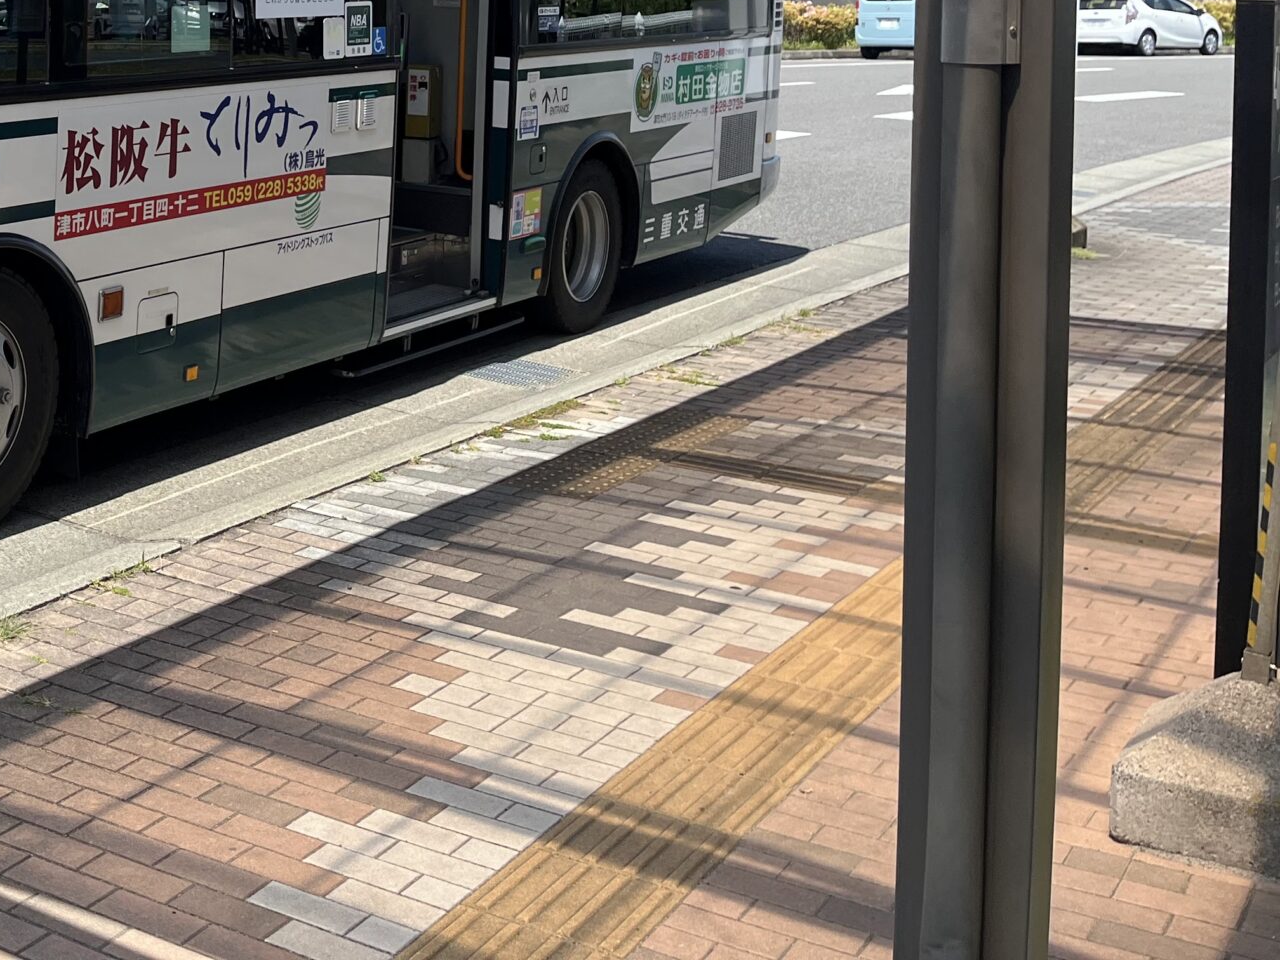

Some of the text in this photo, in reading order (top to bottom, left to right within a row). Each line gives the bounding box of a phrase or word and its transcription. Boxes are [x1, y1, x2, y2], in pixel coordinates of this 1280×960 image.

[350, 14, 367, 27] NBA
[552, 86, 568, 104] 入口
[677, 69, 743, 103] 村田金物店
[60, 91, 319, 195] 松阪牛 とりみつ
[283, 150, 326, 173] (株)鳥光
[643, 203, 705, 243] 三重交通
